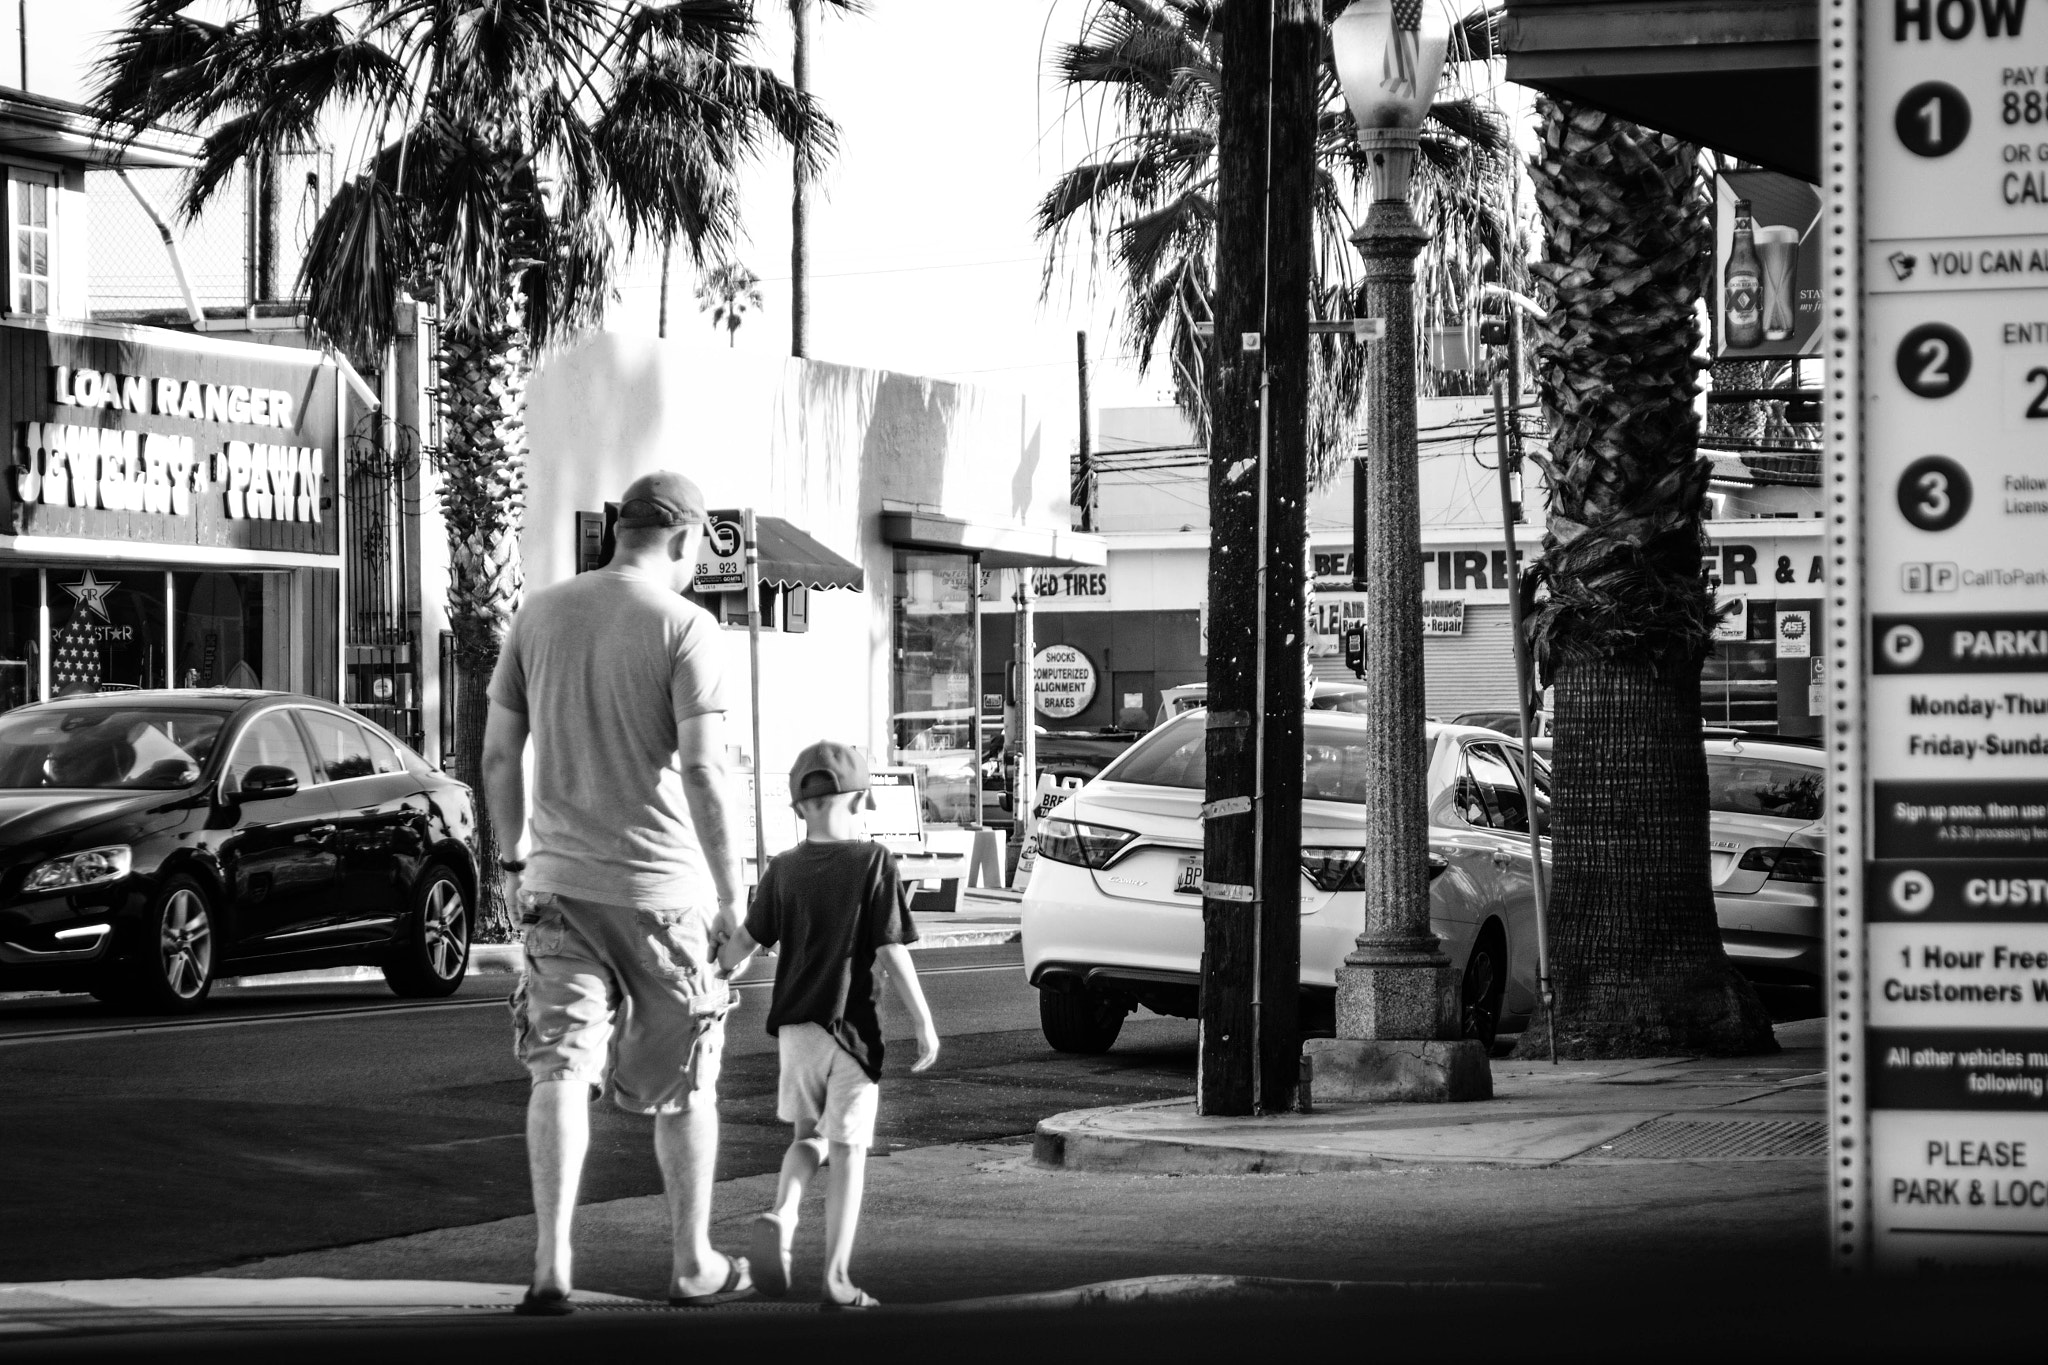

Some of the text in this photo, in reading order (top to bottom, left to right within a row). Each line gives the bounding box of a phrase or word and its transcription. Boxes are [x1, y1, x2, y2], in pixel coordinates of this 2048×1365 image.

[1895, 0, 2026, 42] HOW
[2002, 67, 2037, 86] PAY
[2002, 90, 2048, 125] 88
[2002, 143, 2031, 162] OR
[2002, 170, 2048, 205] CAL
[1930, 251, 1973, 275] YOU
[1979, 250, 2022, 274] CAN
[2003, 321, 2048, 344] ENT
[1917, 337, 1950, 384] 2
[54, 365, 293, 428] LOAN RANGER
[17, 422, 193, 516] JEWELRY
[224, 440, 325, 522] PAWN
[1917, 470, 1950, 517] 3
[719, 561, 738, 574] 923
[1775, 555, 1796, 584] &
[1063, 573, 1107, 596] TIRES
[1431, 619, 1462, 632] Repair
[1783, 621, 1803, 631] ASE
[1953, 629, 2048, 656] PARKI
[1046, 652, 1076, 663] SHOCKS
[1034, 682, 1086, 692] ALIGNMENT
[1044, 697, 1075, 708] BRAKES
[1896, 802, 1927, 824] Sign
[1928, 804, 1948, 822] up
[1987, 802, 2019, 819] then
[2020, 804, 2046, 819] use
[1108, 876, 1148, 887] CAMRY
[1965, 877, 2048, 903] CUST
[1900, 946, 1911, 968] 1
[1924, 946, 1984, 969] Hour
[1884, 978, 2022, 1002] Customers
[1887, 1048, 1910, 1067] All
[1914, 1049, 1955, 1067] other
[1958, 1047, 2024, 1067] vehicles
[1968, 1072, 2043, 1097] following
[1927, 1140, 2027, 1168] PLEASE
[1892, 1177, 2048, 1207] PARK & LOC
